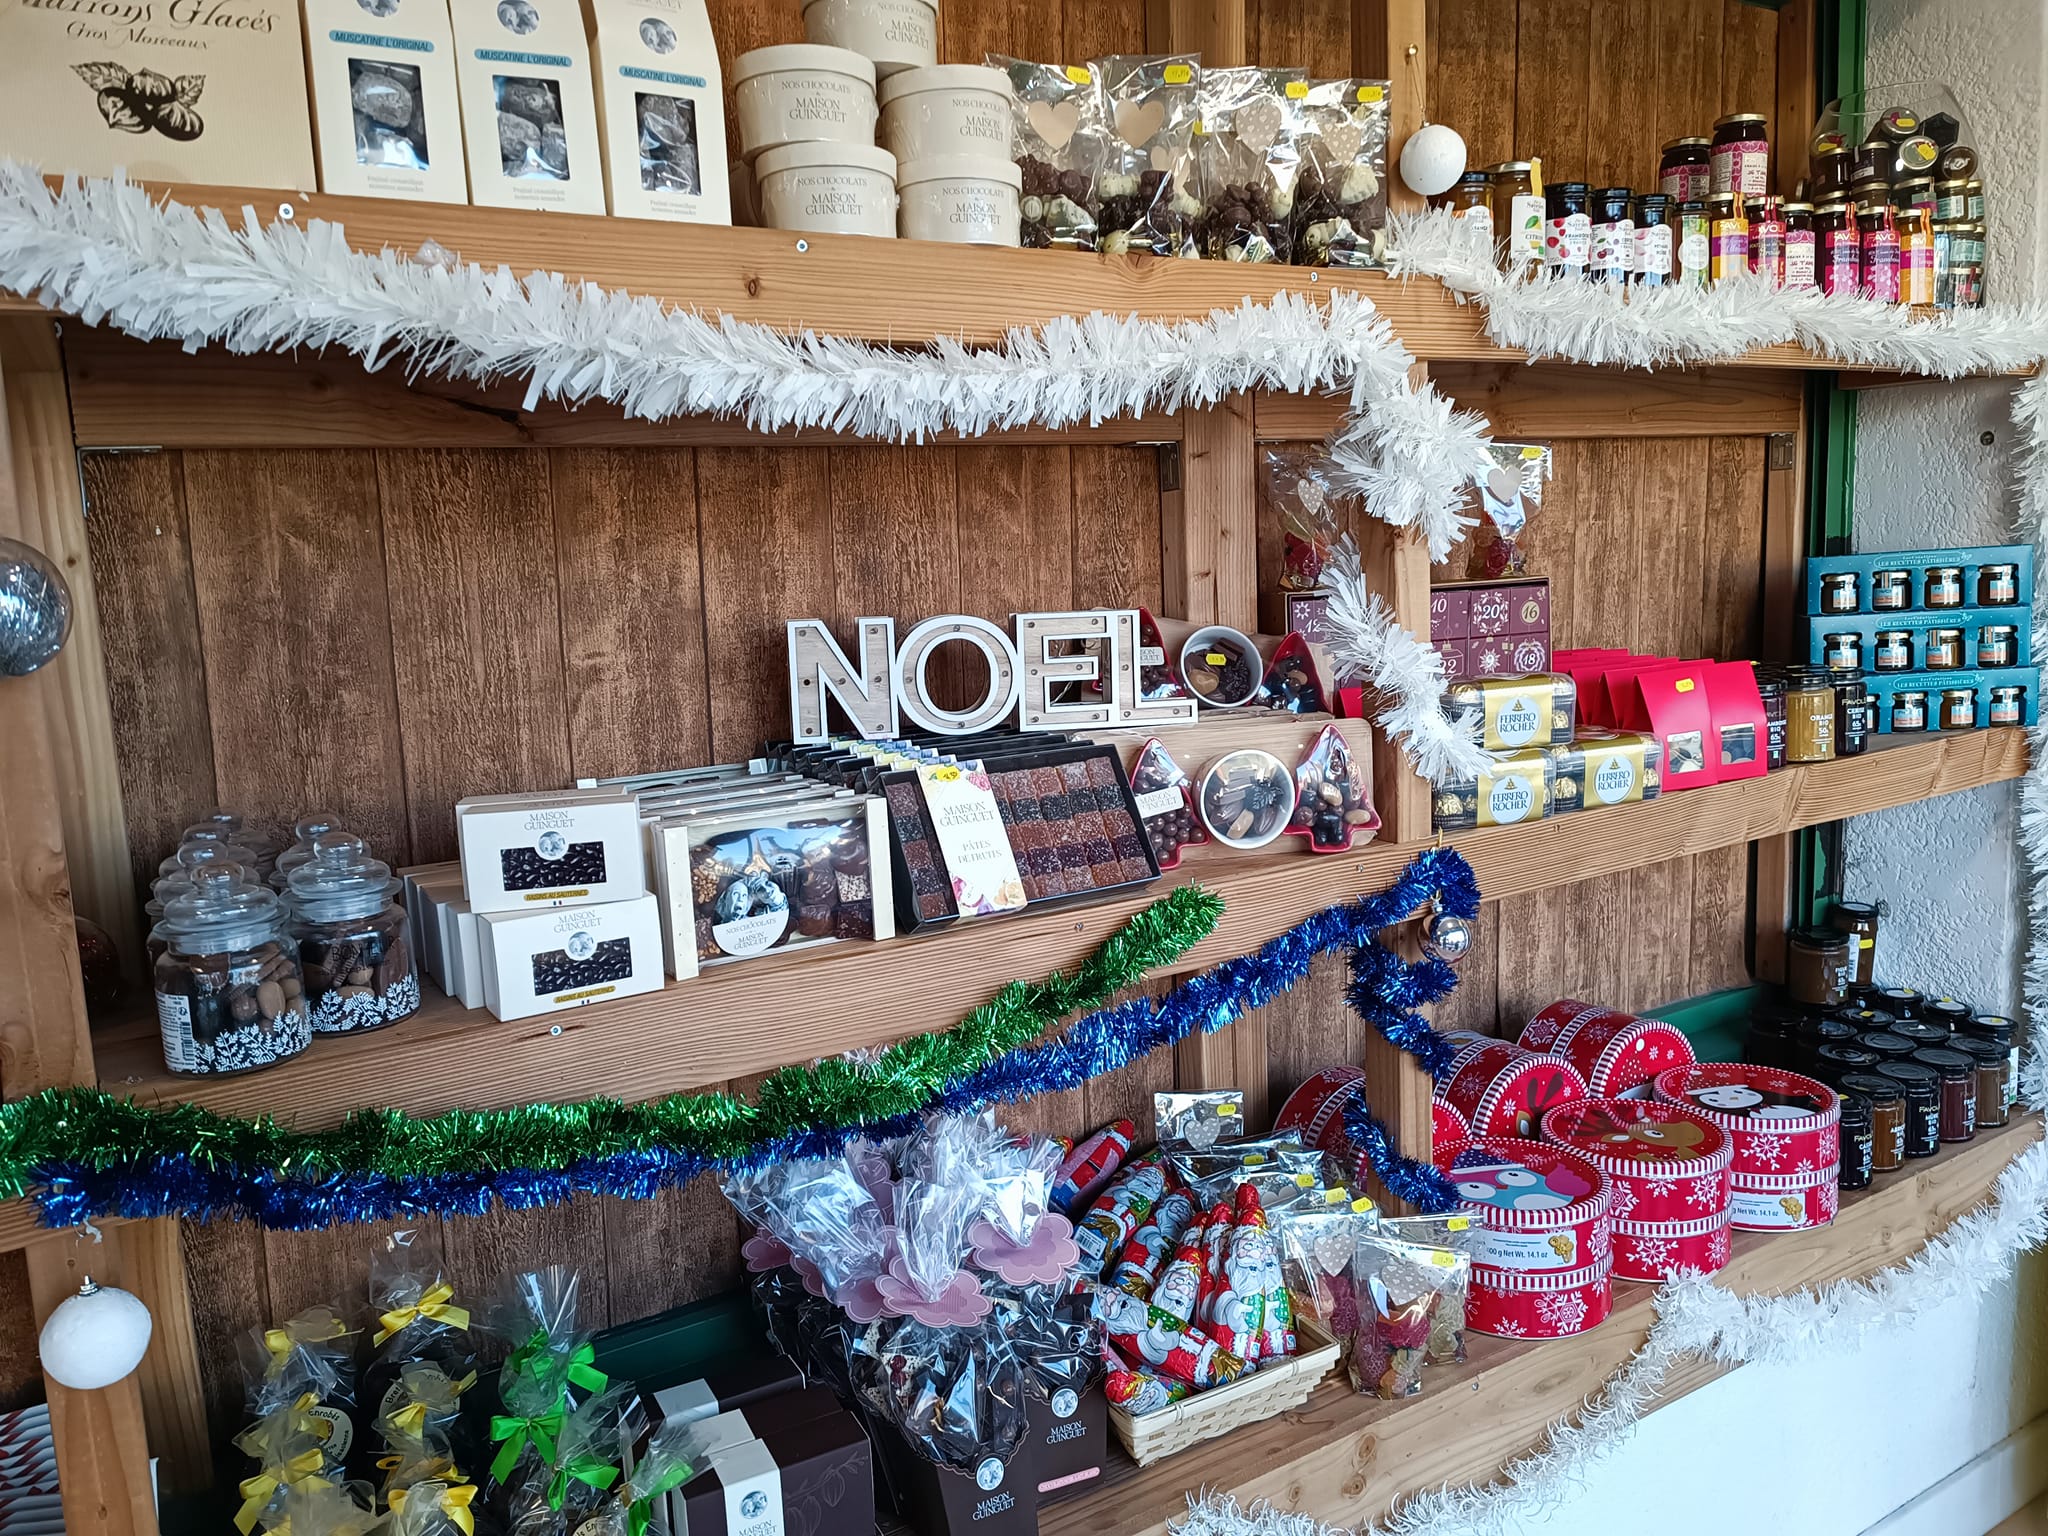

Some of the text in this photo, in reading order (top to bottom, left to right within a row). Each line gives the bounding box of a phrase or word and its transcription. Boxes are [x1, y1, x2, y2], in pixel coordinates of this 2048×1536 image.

[66, 20, 209, 50] Gros Morceaux
[335, 31, 429, 52] MUSCATINE L'ORIGINAL
[481, 50, 569, 67] MUSCATINE L'ORIGINAL
[624, 66, 703, 88] MUSCATINE L'ORIGINAL
[782, 80, 800, 91] NOS
[796, 97, 840, 110] MAISON
[789, 108, 846, 123] GUINGUET
[966, 115, 1000, 130] MAISON
[960, 126, 1004, 143] GUINGUET
[797, 176, 815, 186] NOS
[942, 186, 960, 197] NOS
[812, 193, 856, 205] MAISON
[805, 204, 863, 216] GUINGUET
[1483, 604, 1501, 620] 20
[1524, 604, 1539, 620] 16
[1524, 653, 1536, 665] 18
[786, 609, 1198, 745] NOEL
[1500, 712, 1537, 723] FERRERO
[1500, 722, 1536, 733] ROCHER
[1597, 769, 1631, 781] FERRERO
[1597, 779, 1630, 791] ROCHER
[1492, 790, 1529, 801] FERRERO
[943, 801, 986, 817] MAISON
[1492, 800, 1528, 812] ROCHER
[529, 810, 569, 822] MAISON
[939, 810, 995, 827] GUINGUET
[524, 818, 575, 831] GUINGUET
[962, 839, 991, 852] PÂTES
[558, 909, 596, 924] MAISON
[553, 917, 602, 934] GUINGUET
[734, 936, 769, 950] GUINGUET
[738, 931, 766, 943] MAISON
[1737, 1207, 1748, 1215] Net
[1760, 1209, 1771, 1217] 14.1
[1497, 1250, 1503, 1258] g
[1503, 1249, 1515, 1258] Net
[1515, 1250, 1526, 1259] Wt.
[1527, 1251, 1540, 1259] 14.1
[1051, 1420, 1083, 1436] MAISON
[1046, 1426, 1088, 1445] GUINGUET
[976, 1490, 1010, 1511] MAISON
[972, 1496, 1016, 1521] GUINGUET
[738, 1519, 772, 1536] MAISON
